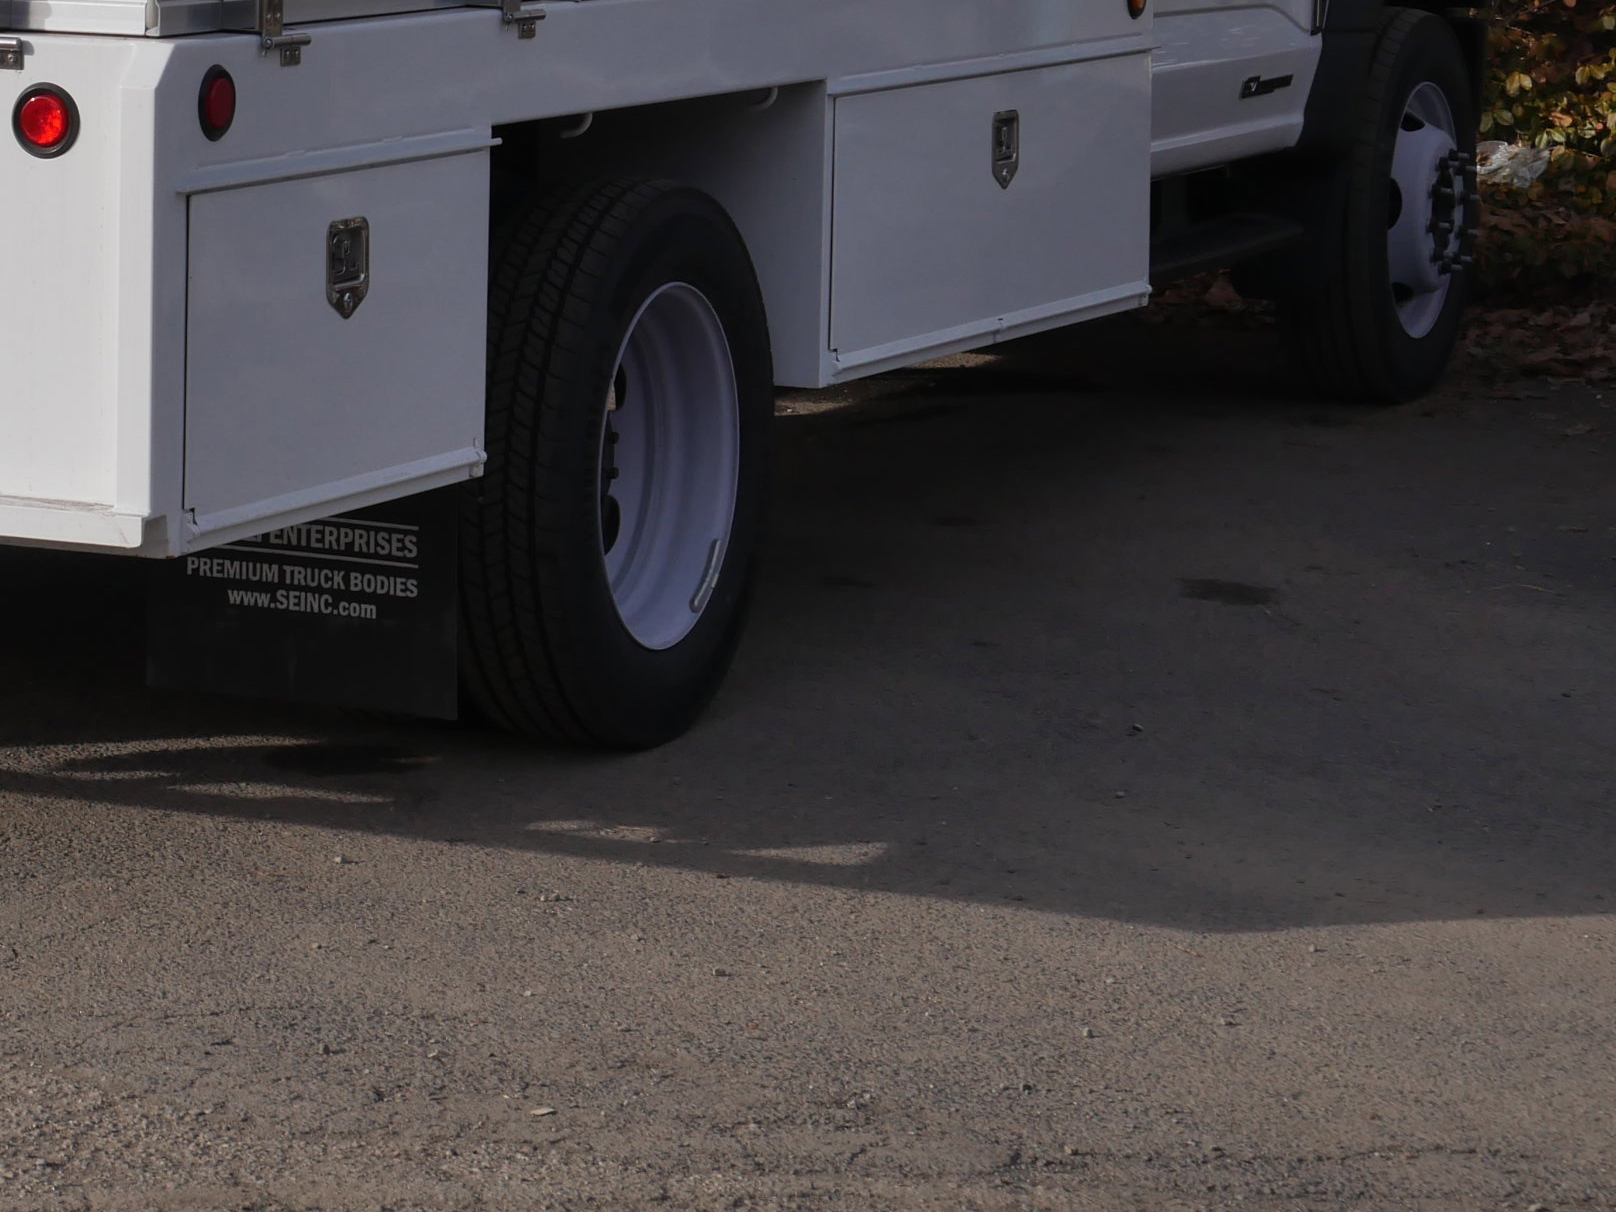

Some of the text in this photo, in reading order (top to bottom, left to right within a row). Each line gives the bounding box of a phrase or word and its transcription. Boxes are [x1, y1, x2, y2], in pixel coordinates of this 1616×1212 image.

[269, 523, 418, 558] ENTERPRISES
[186, 556, 418, 598] PREMIUM TRUCK BODIES
[227, 589, 377, 620] www.SEINC.com
